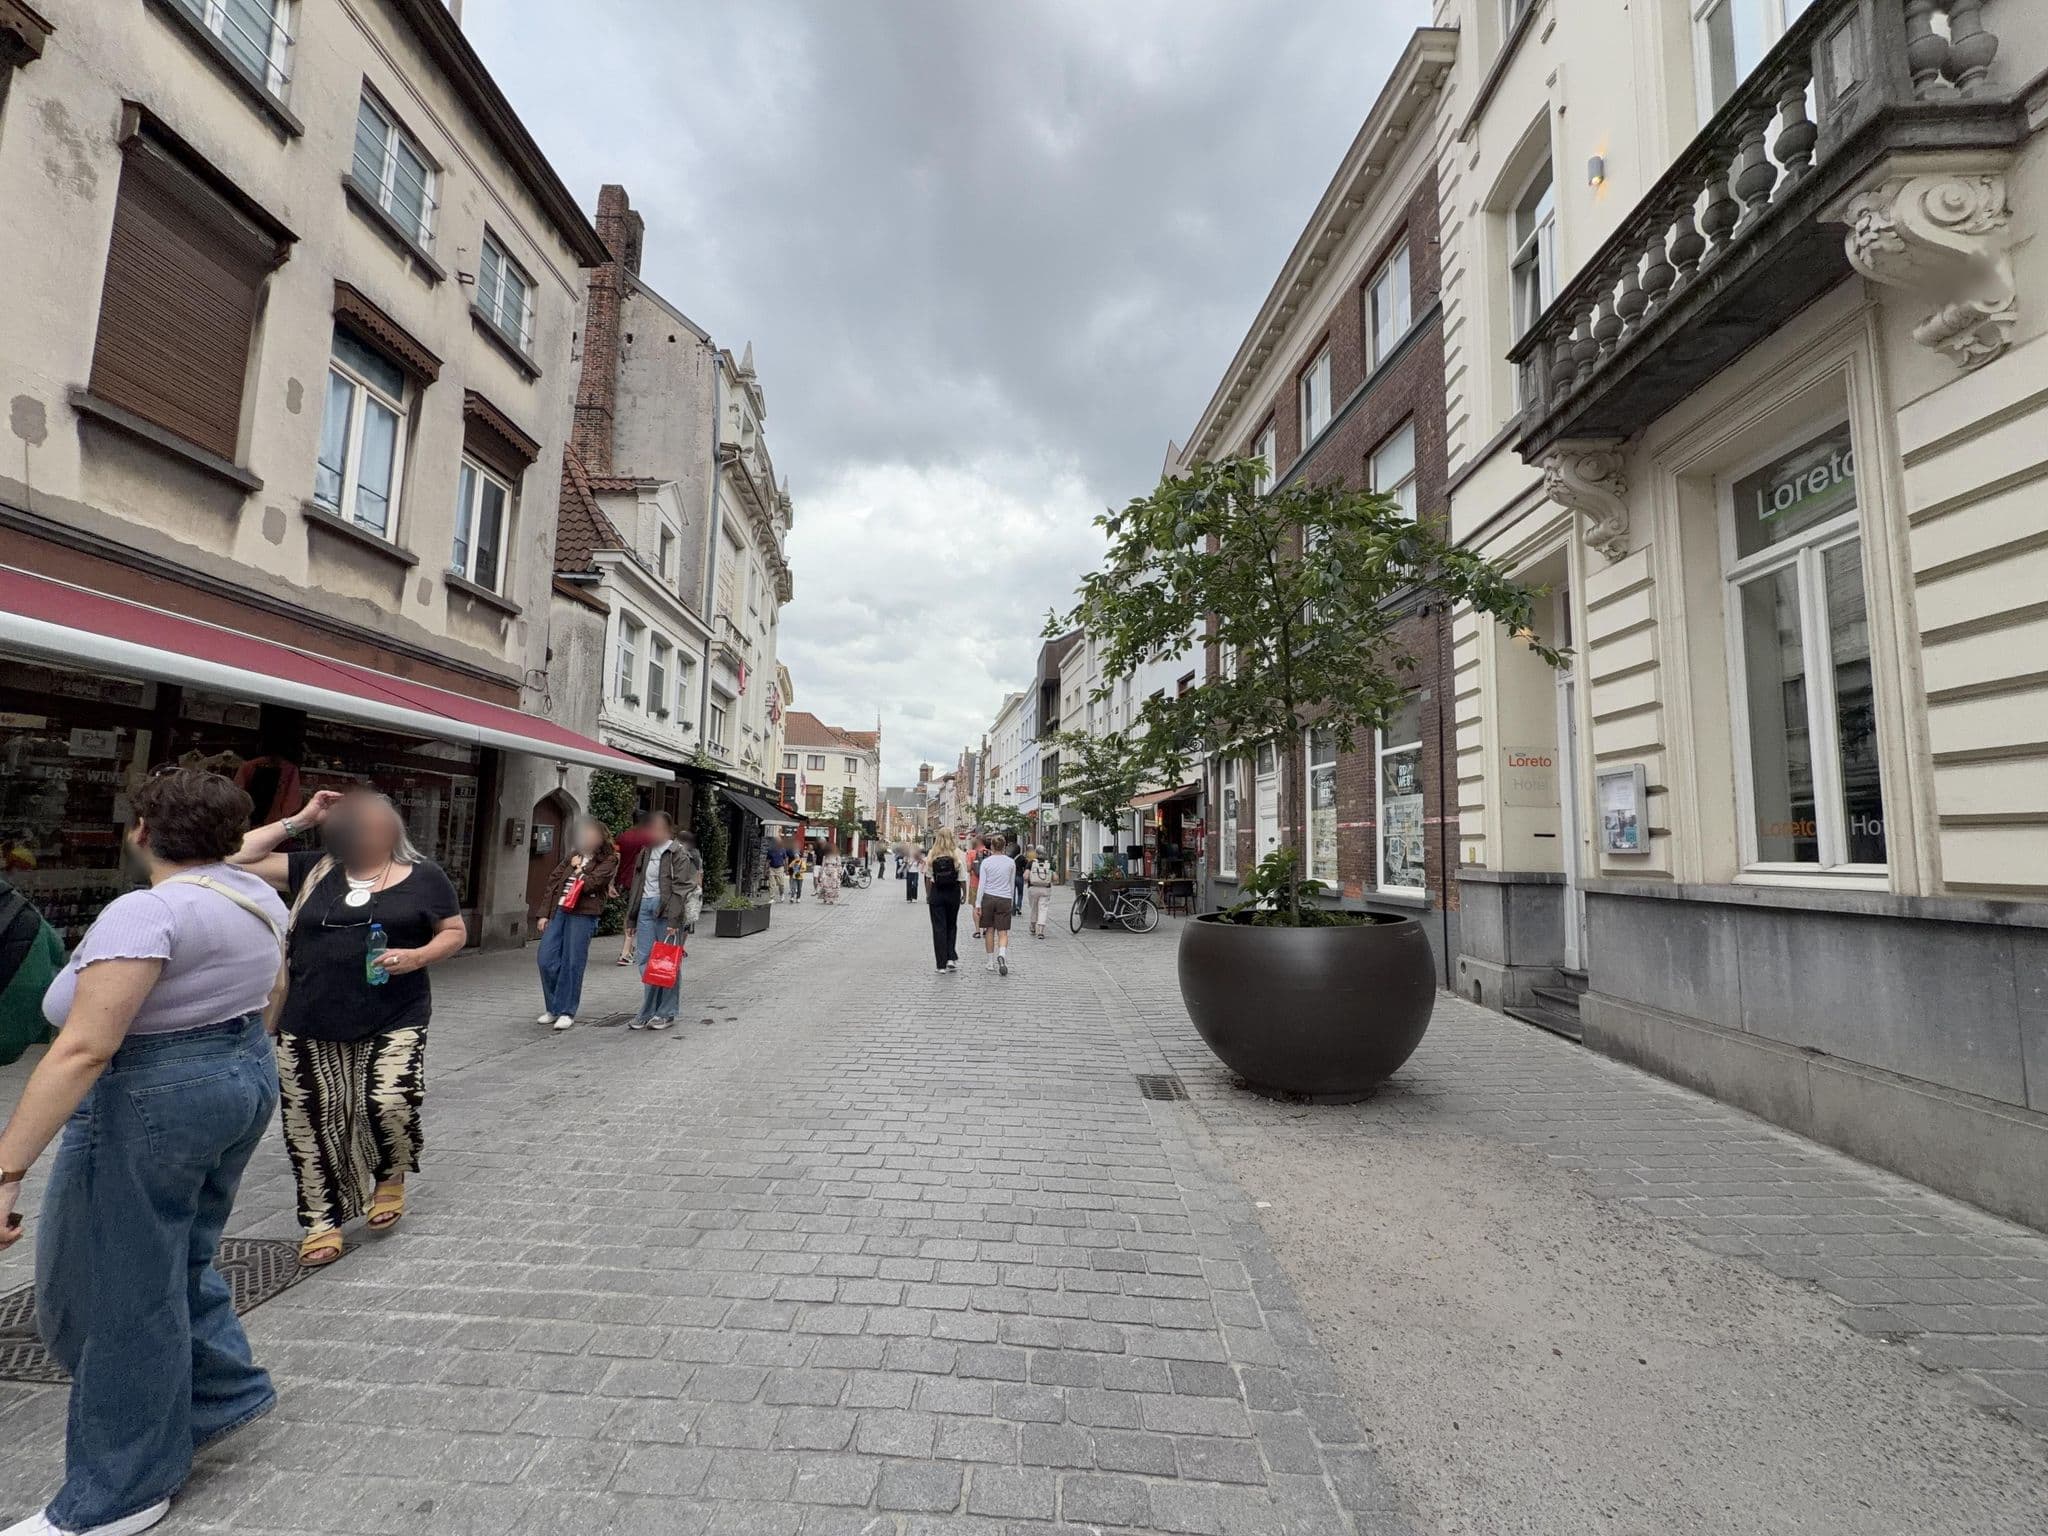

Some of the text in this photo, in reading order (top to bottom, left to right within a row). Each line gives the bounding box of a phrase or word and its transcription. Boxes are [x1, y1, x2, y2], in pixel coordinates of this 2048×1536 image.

[1756, 450, 1855, 521] Loreto
[1508, 755, 1552, 768] Loreto
[1850, 815, 1885, 836] Ho
